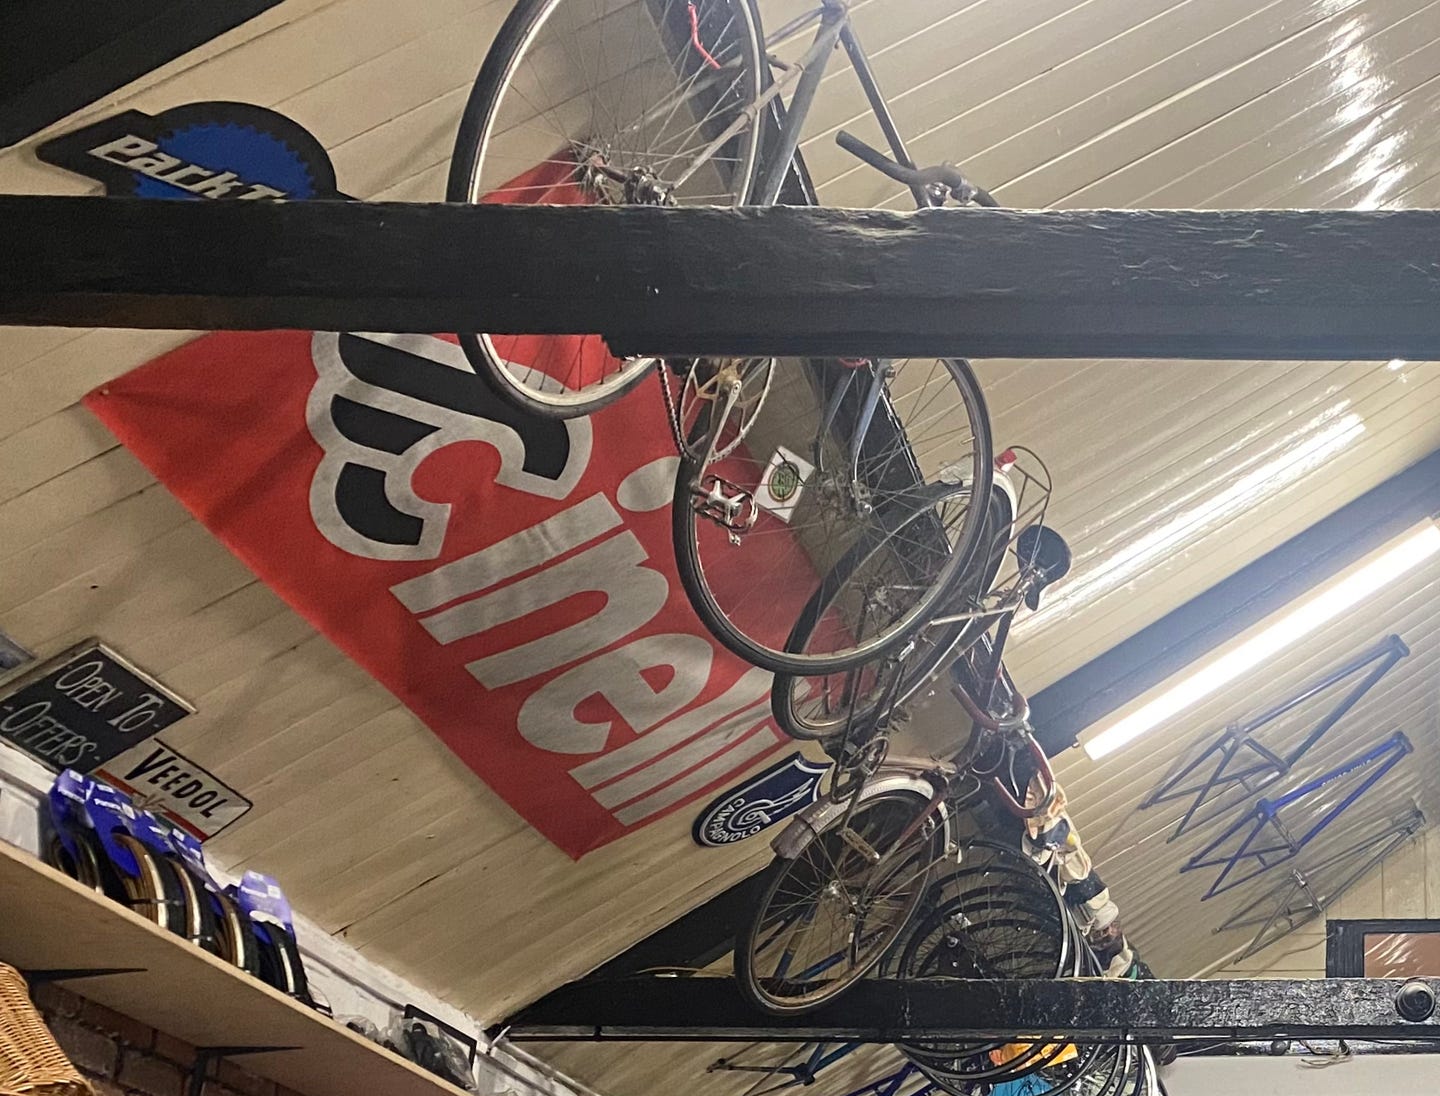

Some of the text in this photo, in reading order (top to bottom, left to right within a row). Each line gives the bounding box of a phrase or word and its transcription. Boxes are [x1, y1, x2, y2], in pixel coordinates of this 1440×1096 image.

[88, 134, 288, 200] ParkT
[1, 701, 98, 765] OFFERS
[124, 747, 229, 819] VEEDOL
[708, 797, 761, 843] CAMPAGNOLO
